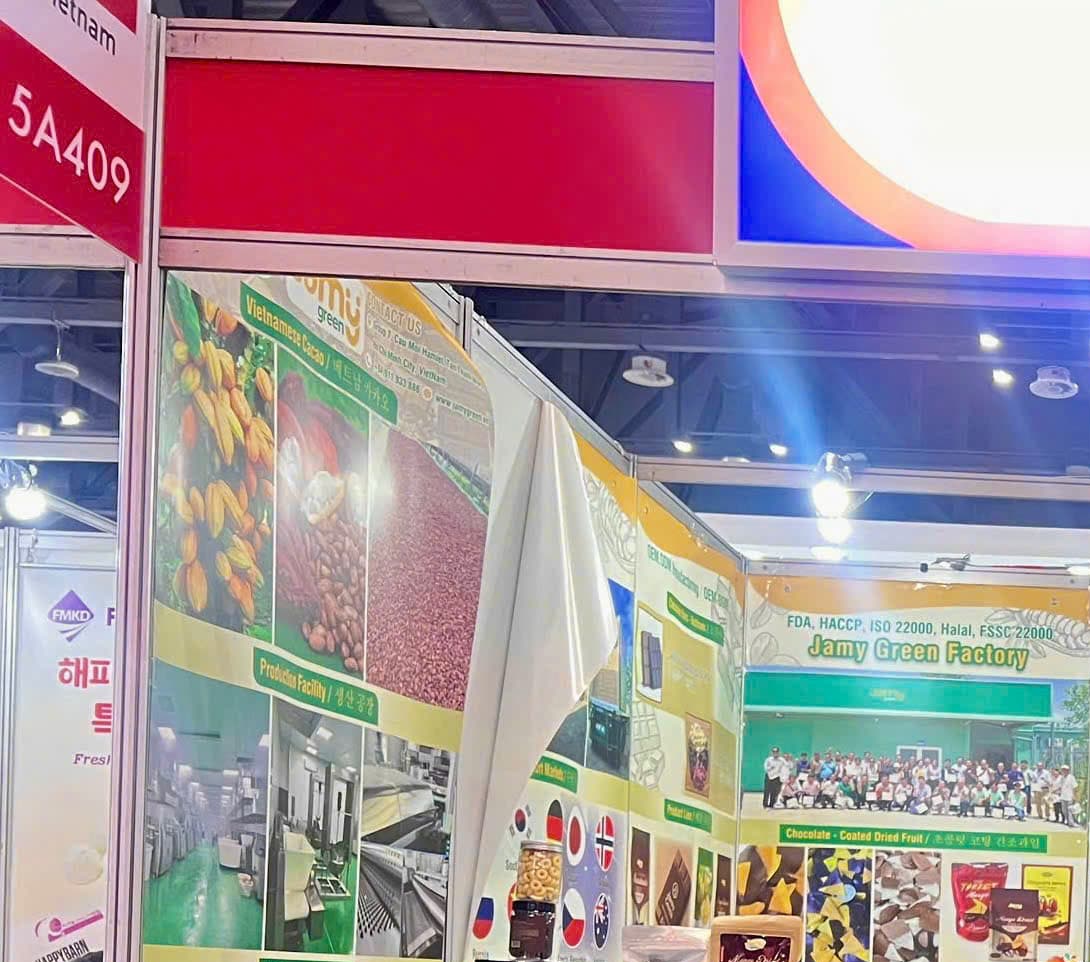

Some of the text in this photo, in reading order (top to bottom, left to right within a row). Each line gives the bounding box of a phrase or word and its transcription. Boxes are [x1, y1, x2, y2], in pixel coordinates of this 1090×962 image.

[8, 83, 130, 204] 5A409
[246, 294, 301, 347] Vietnamese
[302, 334, 324, 366] Cacao
[317, 304, 344, 335] green
[52, 608, 89, 622] FMKD
[787, 615, 1053, 641] FDA, HACCP, ISO 22000, Halal, FSSC 22000
[808, 635, 1029, 671] Jamy Green Factory
[72, 753, 111, 766] Fres
[786, 828, 831, 841] Chocolate
[840, 830, 872, 843] Coated
[874, 832, 899, 844] Dried
[902, 833, 924, 845] Fruit
